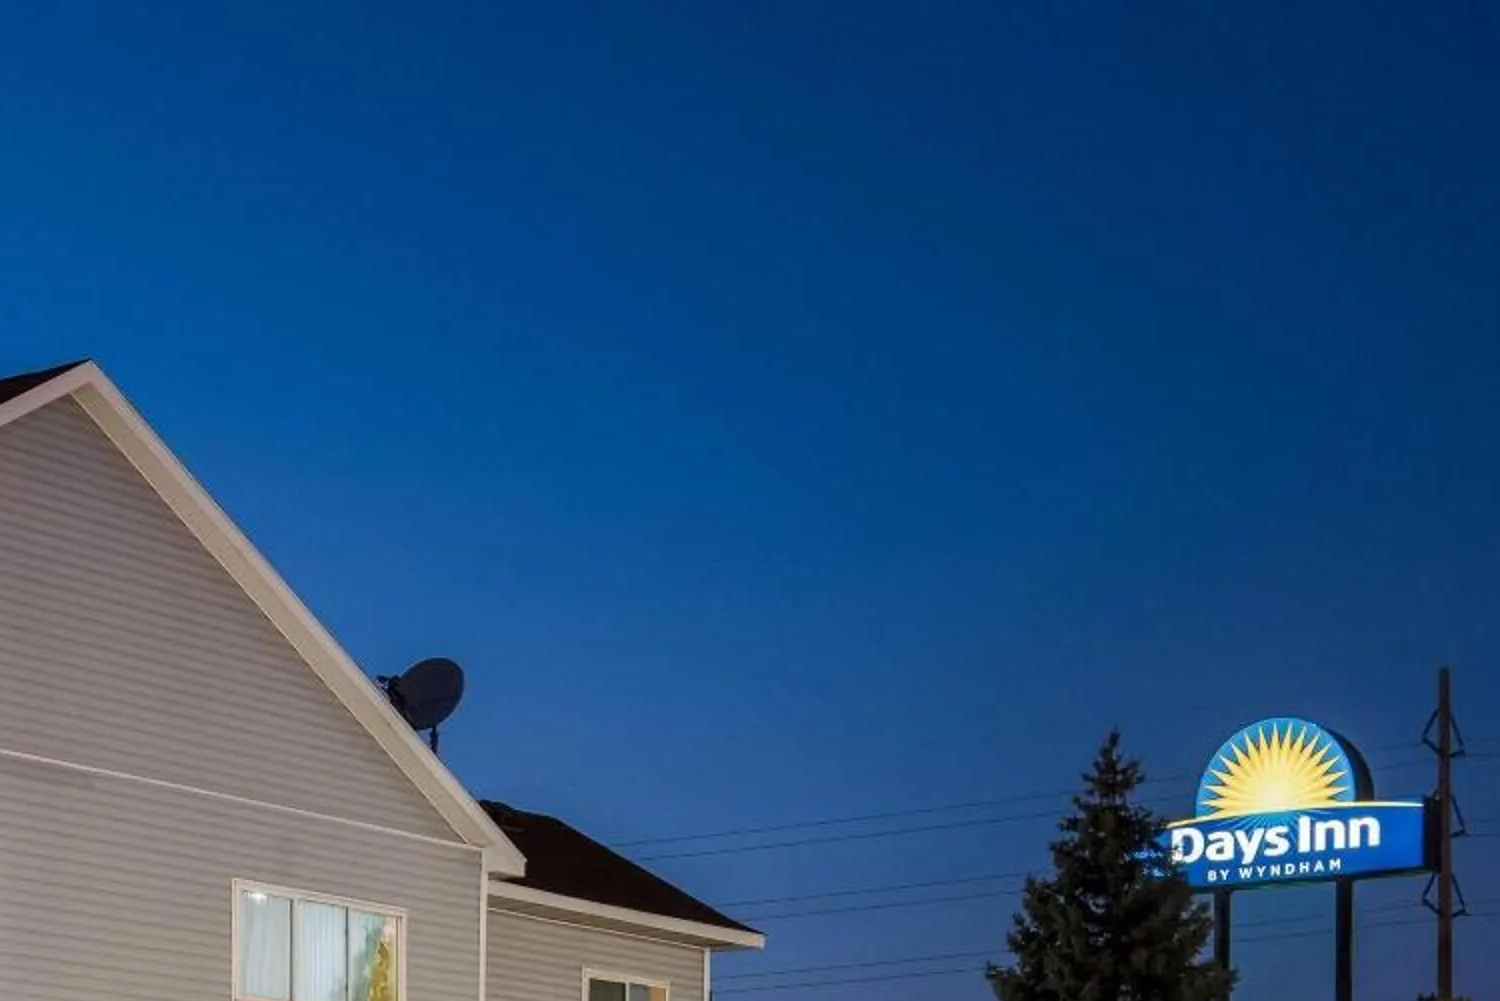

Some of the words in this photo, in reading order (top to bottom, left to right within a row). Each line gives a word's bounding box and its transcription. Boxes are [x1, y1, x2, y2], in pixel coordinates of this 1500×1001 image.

[1171, 823, 1290, 865] Days
[1299, 815, 1381, 852] Inn
[1207, 868, 1229, 882] BY
[1239, 858, 1342, 879] WYNDHAM
